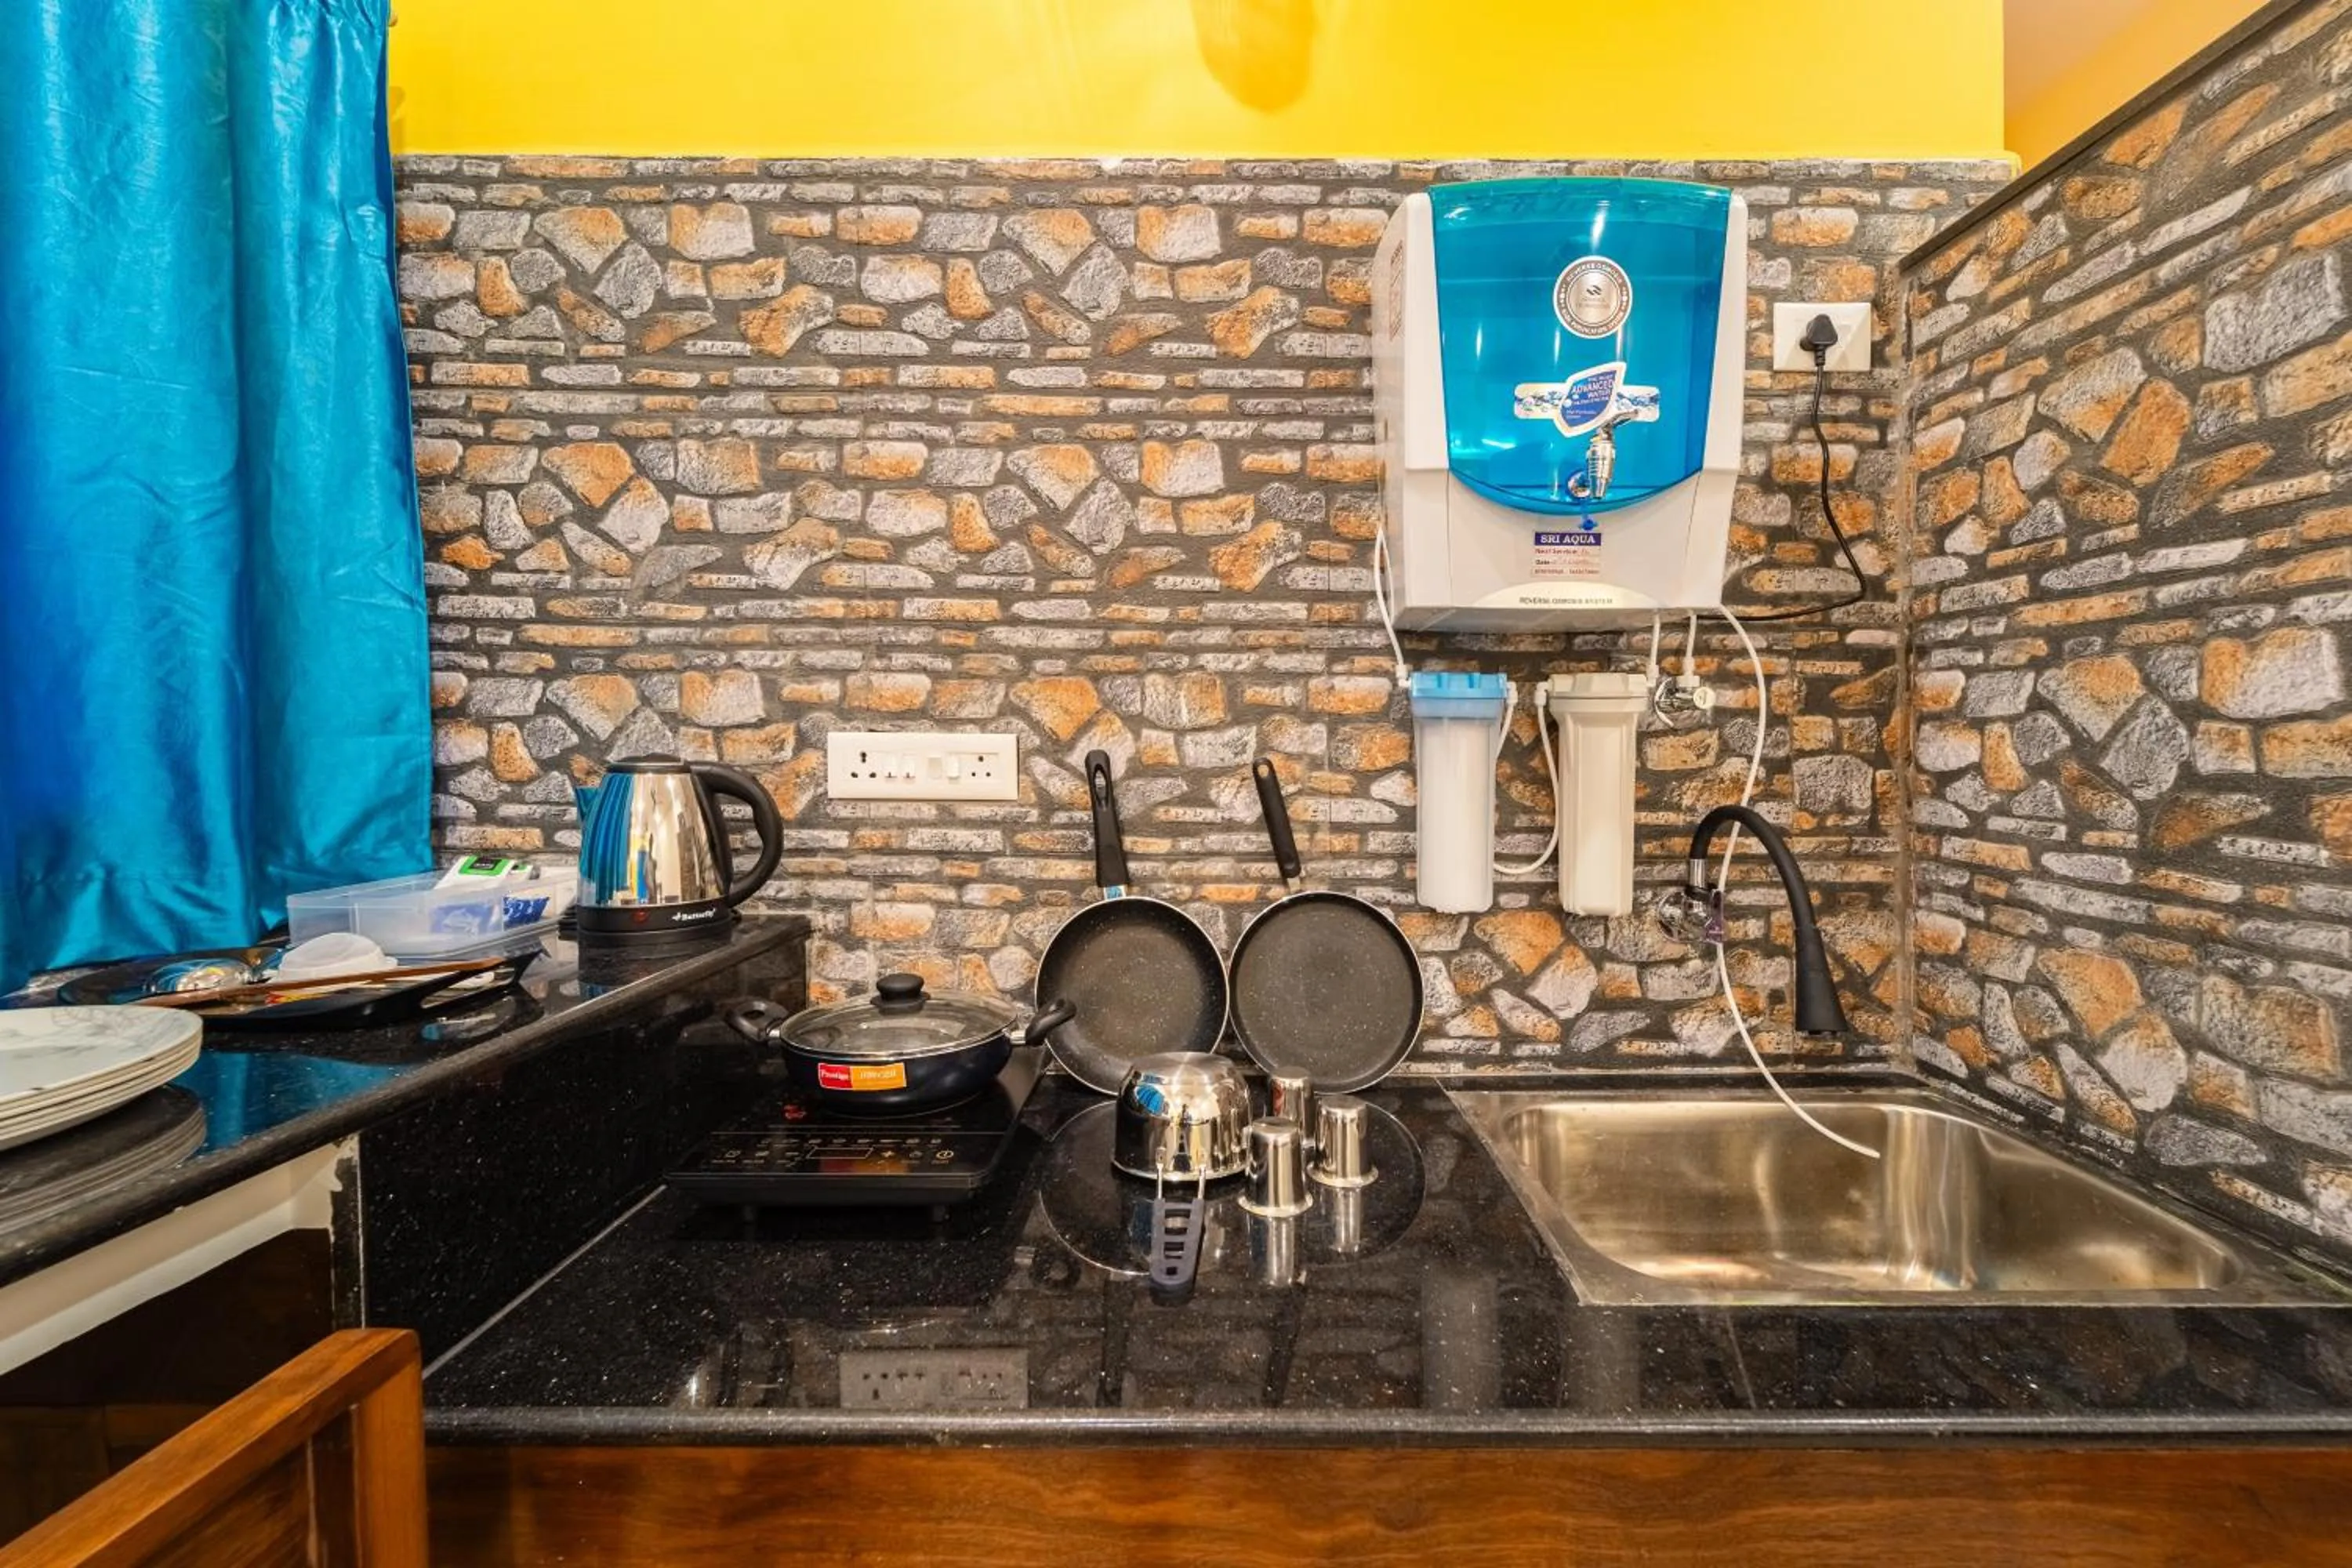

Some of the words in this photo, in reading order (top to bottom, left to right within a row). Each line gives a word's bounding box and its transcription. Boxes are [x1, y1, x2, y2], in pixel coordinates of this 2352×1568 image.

[1571, 379, 1613, 394] ADVANCED
[1540, 535, 1560, 543] SRI
[1563, 535, 1595, 545] AQUA
